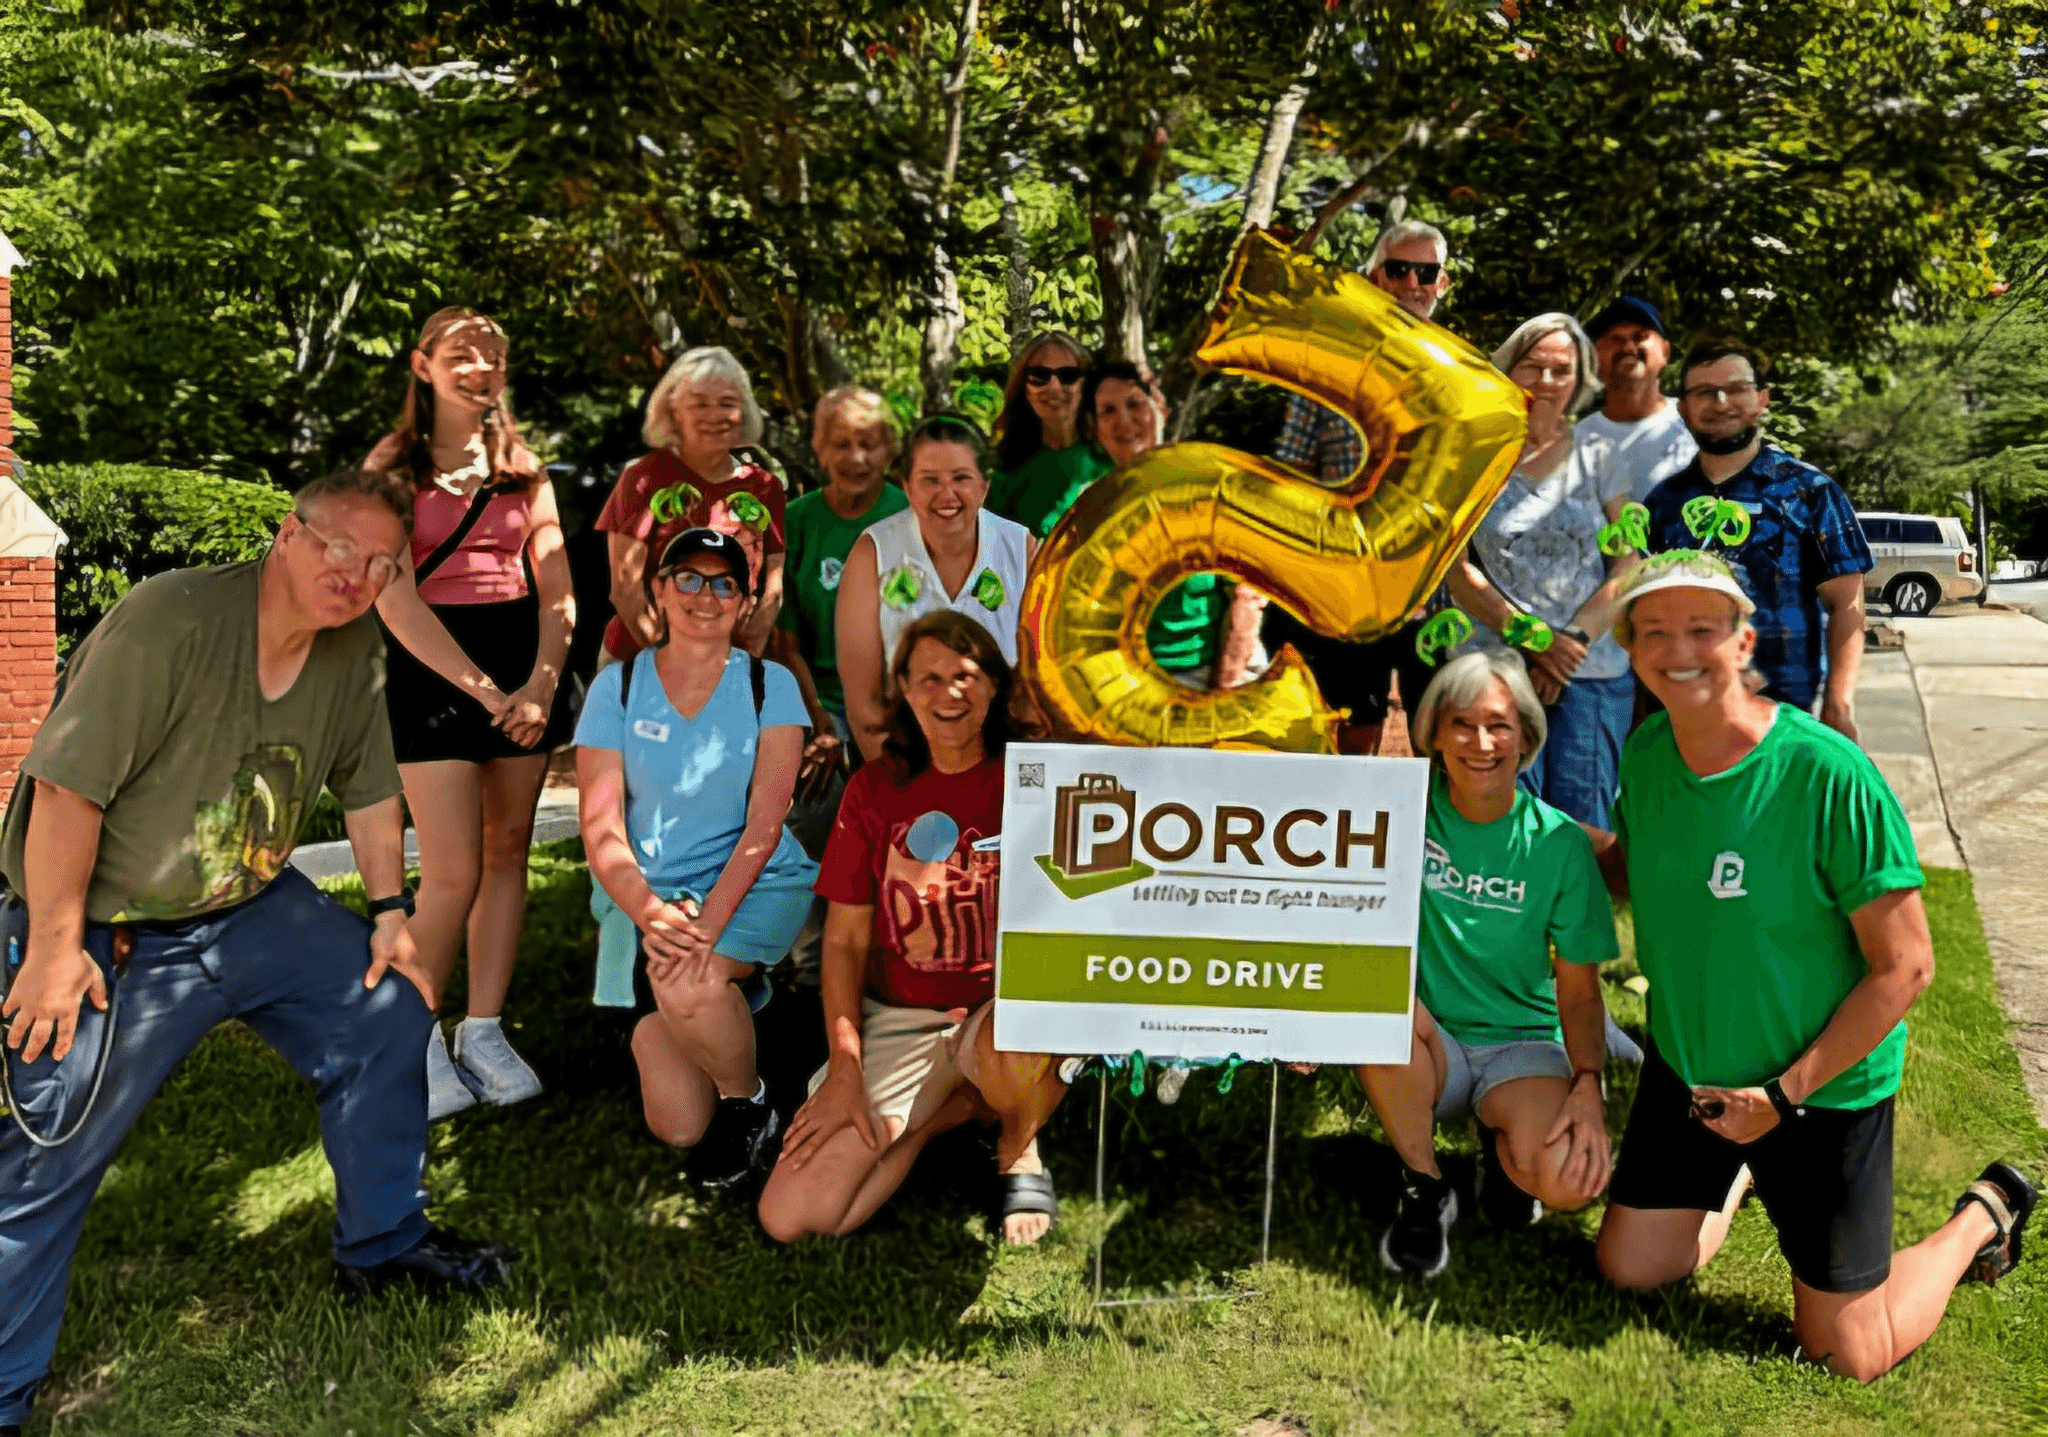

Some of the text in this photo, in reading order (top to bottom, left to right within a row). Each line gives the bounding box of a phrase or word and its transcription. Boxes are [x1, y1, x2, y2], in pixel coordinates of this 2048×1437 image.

[1077, 801, 1390, 869] PORCH
[1086, 955, 1324, 990] FOOD DRIVE
